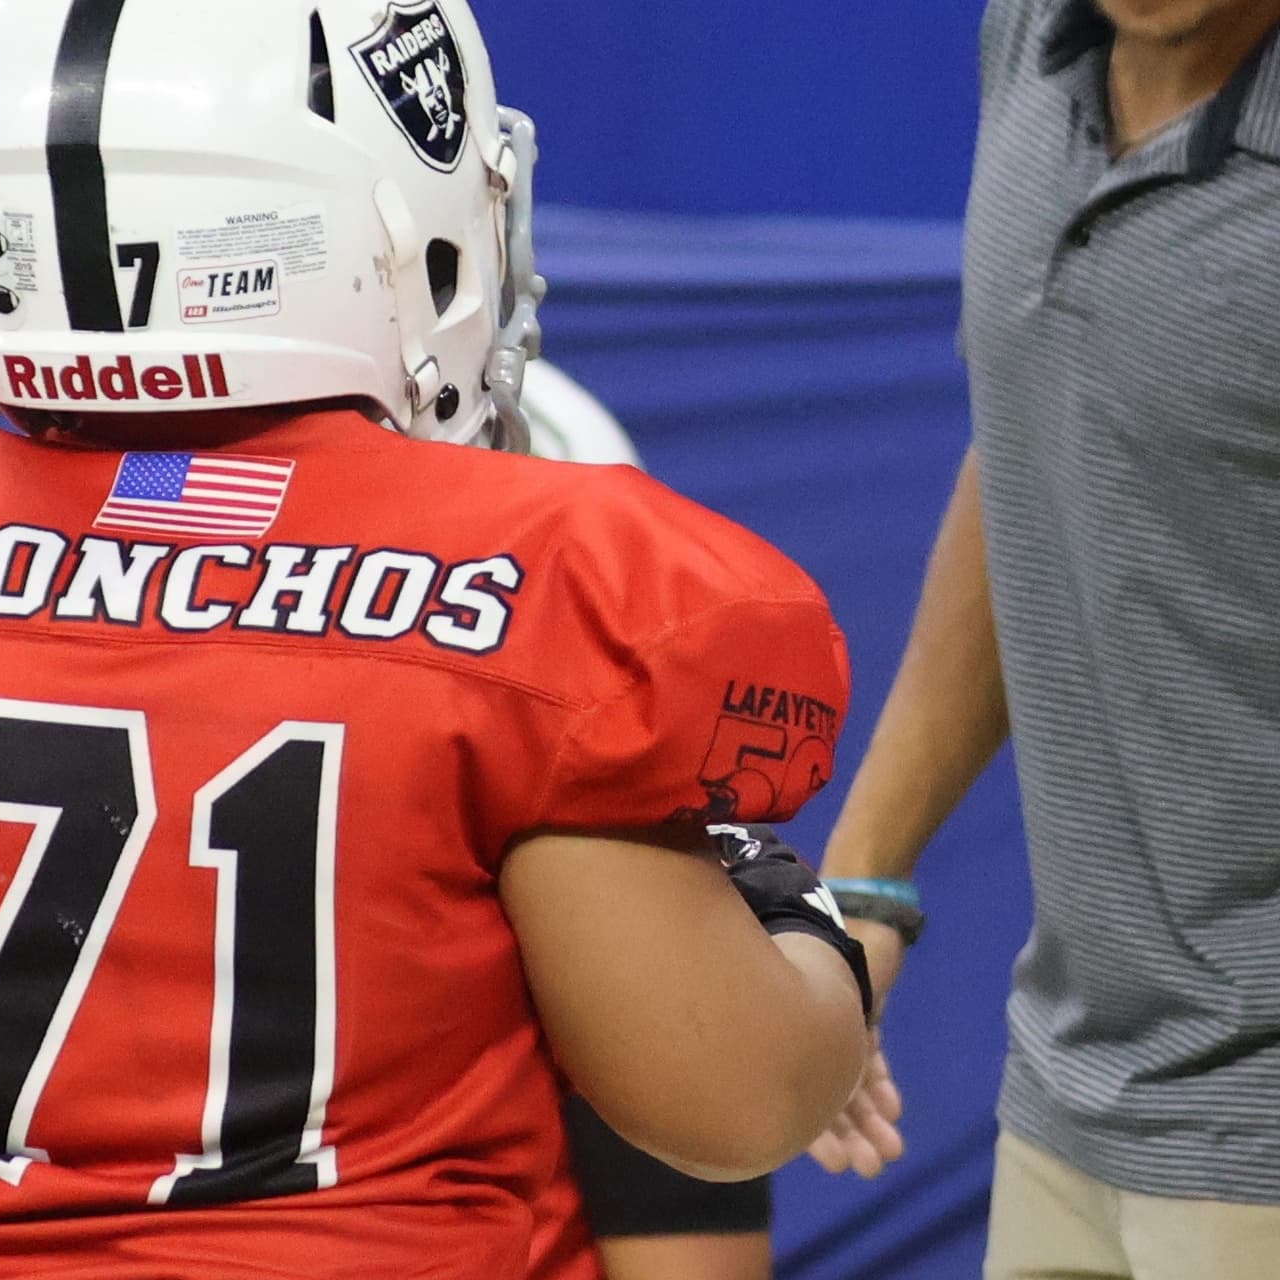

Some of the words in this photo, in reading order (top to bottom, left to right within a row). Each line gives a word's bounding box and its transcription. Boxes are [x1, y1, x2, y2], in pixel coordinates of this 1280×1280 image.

[369, 13, 445, 76] RAIDERS
[225, 211, 279, 225] WARNING
[115, 241, 160, 328] 7
[207, 266, 275, 298] TEAM
[3, 353, 230, 400] Riddell
